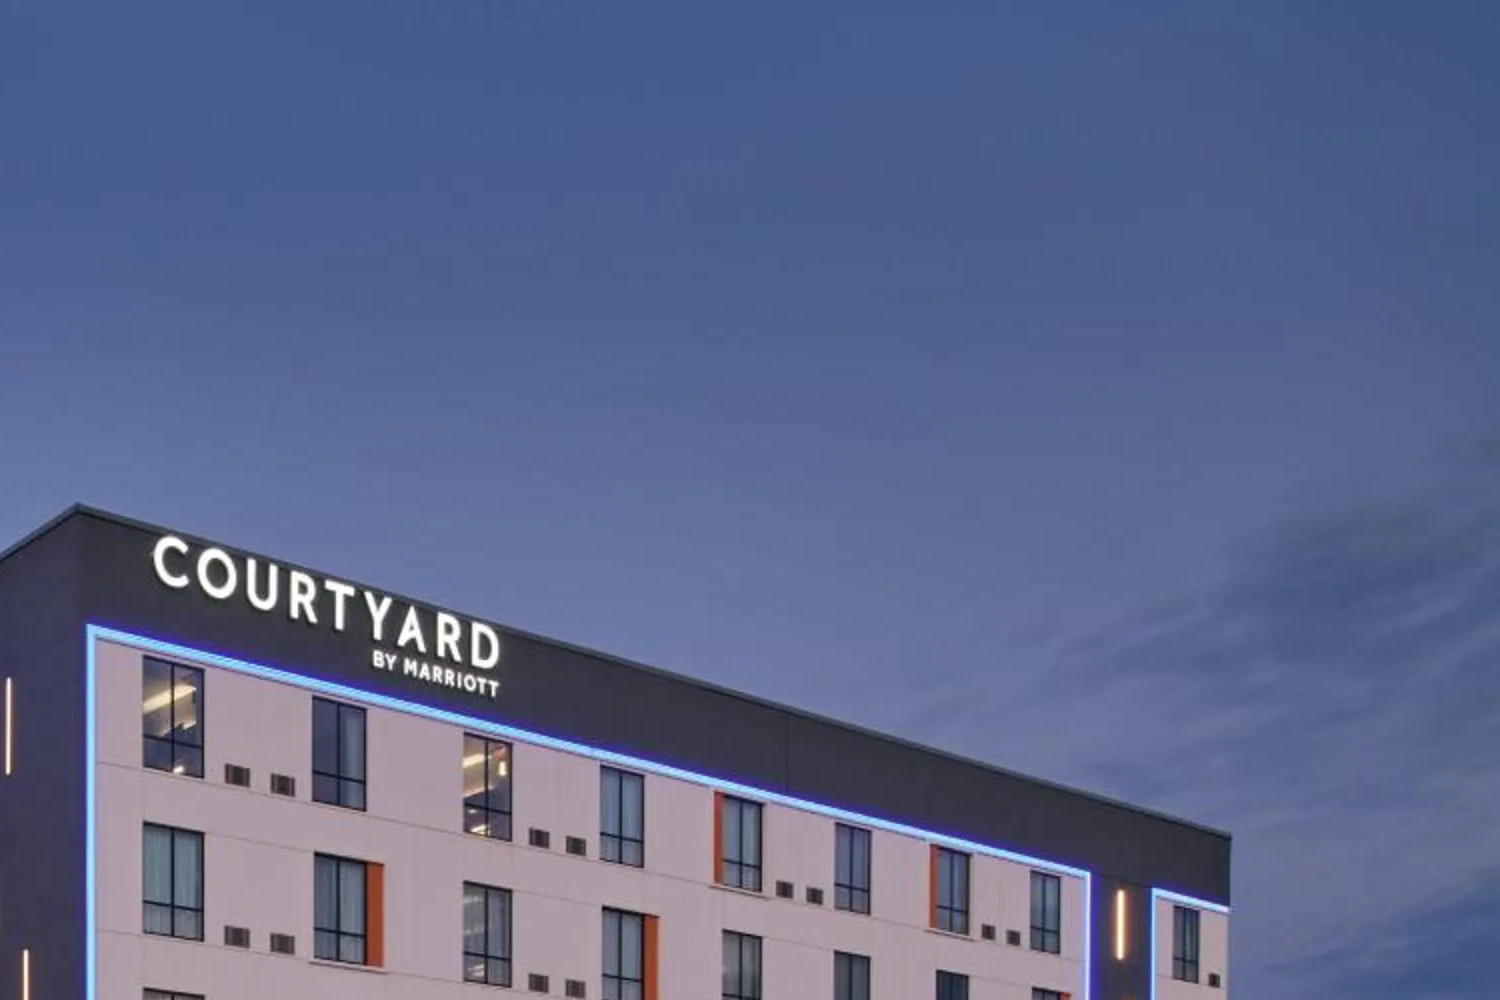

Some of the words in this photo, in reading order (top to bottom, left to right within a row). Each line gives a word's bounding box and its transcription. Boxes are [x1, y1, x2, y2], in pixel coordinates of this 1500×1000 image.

[152, 535, 500, 669] COURTYARD
[372, 649, 397, 671] BY
[403, 657, 500, 698] MARRIOTT
